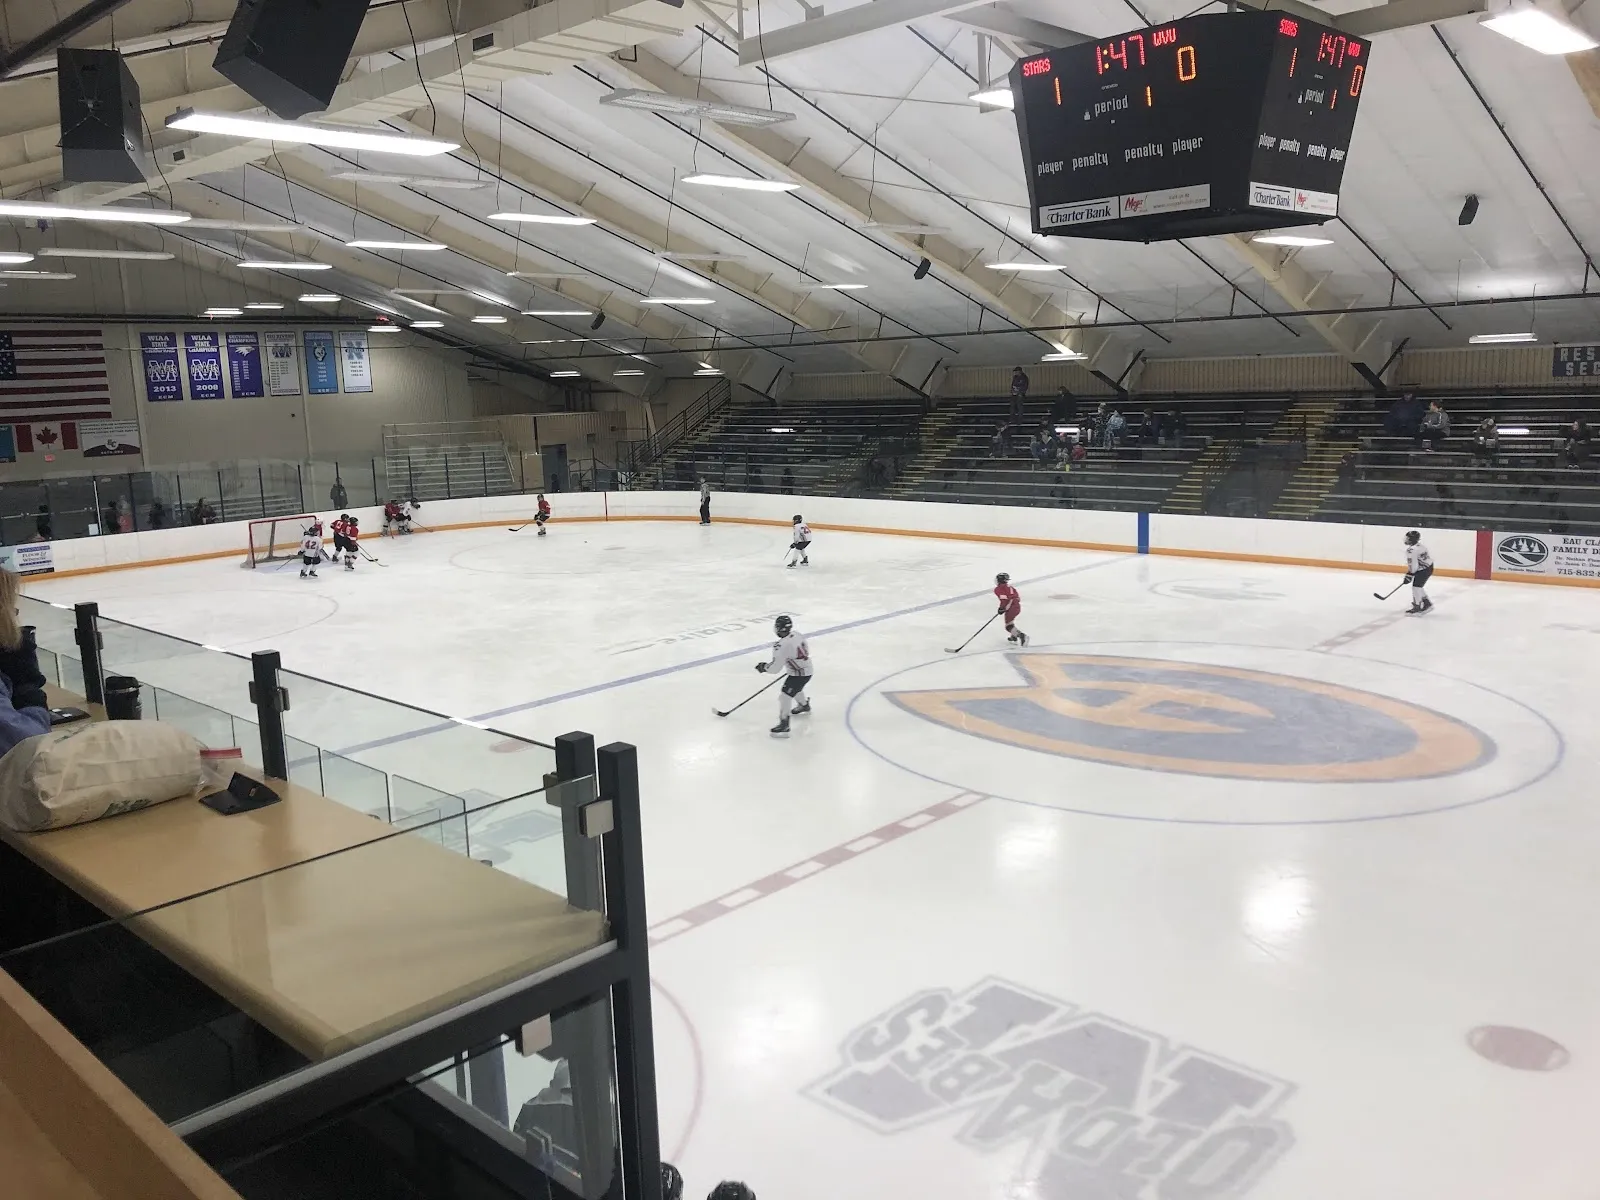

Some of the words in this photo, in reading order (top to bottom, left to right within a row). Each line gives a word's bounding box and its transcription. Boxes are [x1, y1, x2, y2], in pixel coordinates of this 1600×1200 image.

[1152, 27, 1177, 47] WVU
[1095, 33, 1146, 76] 1:47
[1317, 32, 1347, 68] 1:47
[1023, 57, 1051, 77] STARS
[1177, 45, 1197, 82] 0
[1289, 47, 1299, 78] 1
[1054, 77, 1062, 106] 1
[1349, 64, 1364, 97] 0
[1094, 94, 1128, 117] period
[1145, 85, 1152, 107] 1
[1305, 88, 1325, 103] period
[1330, 88, 1339, 110] 1
[1037, 159, 1064, 176] player
[1072, 152, 1109, 171] penalty
[1124, 142, 1164, 162] penalty
[1172, 136, 1203, 155] player
[1258, 132, 1276, 150] player
[1279, 138, 1300, 155] penalty
[1306, 144, 1327, 160] penalty
[153, 385, 177, 393] 2013
[305, 540, 317, 549] 42
[1553, 546, 1588, 554] FAMILY
[1562, 537, 1582, 545] EAU
